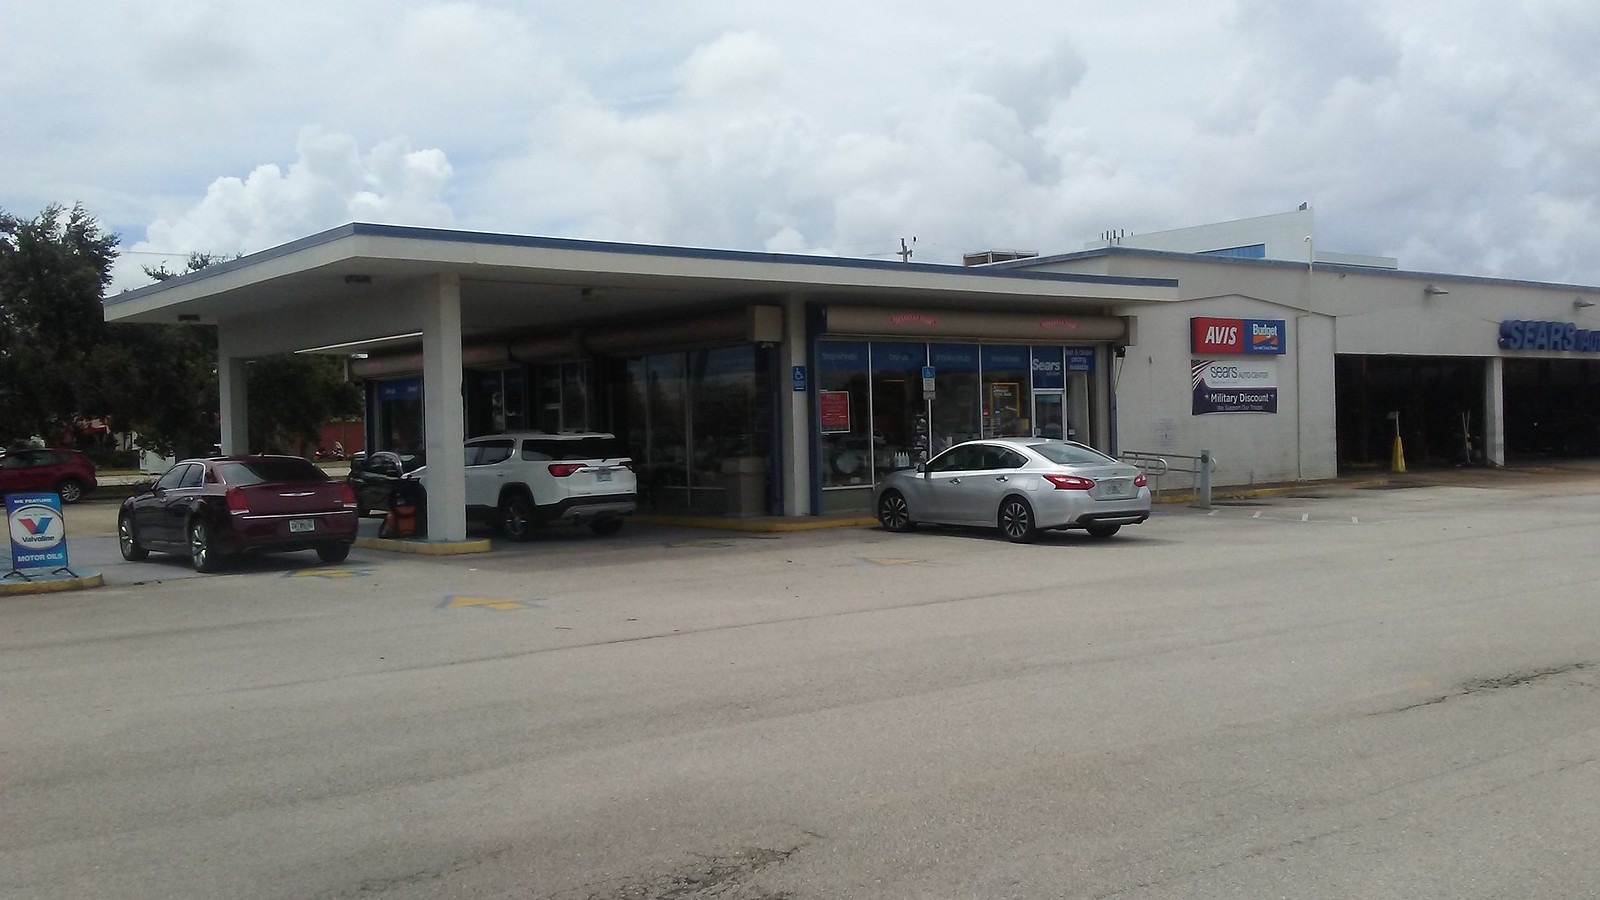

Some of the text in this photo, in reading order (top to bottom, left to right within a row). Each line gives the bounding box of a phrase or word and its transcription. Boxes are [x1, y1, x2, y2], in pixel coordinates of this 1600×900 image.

[1204, 326, 1238, 345] AVIS
[1252, 323, 1278, 338] Budget
[1504, 319, 1577, 351] SEARS
[1032, 358, 1061, 371] Sears
[1210, 393, 1269, 404] Military Discount
[22, 535, 55, 543] Valvoline
[17, 554, 46, 562] MOTOR
